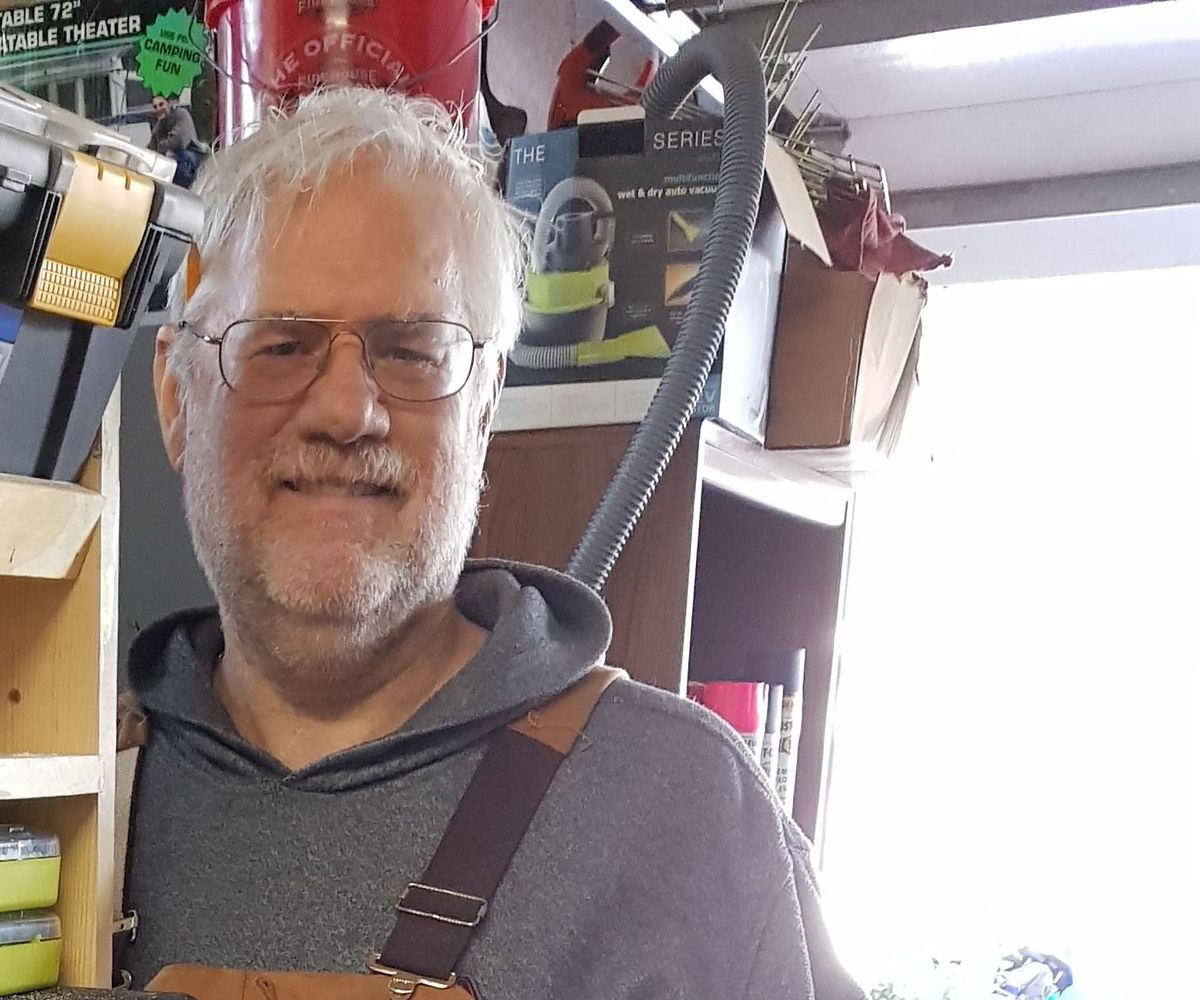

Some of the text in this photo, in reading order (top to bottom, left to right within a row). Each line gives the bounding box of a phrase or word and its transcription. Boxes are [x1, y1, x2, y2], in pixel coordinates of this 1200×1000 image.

[63, 14, 141, 43] THEATER
[144, 38, 202, 63] CAMPING
[155, 58, 181, 76] FUN
[653, 128, 724, 150] SERIES
[514, 144, 546, 165] THE
[663, 172, 721, 184] multifunctio
[617, 184, 718, 200] wet & dry auto vacuu
